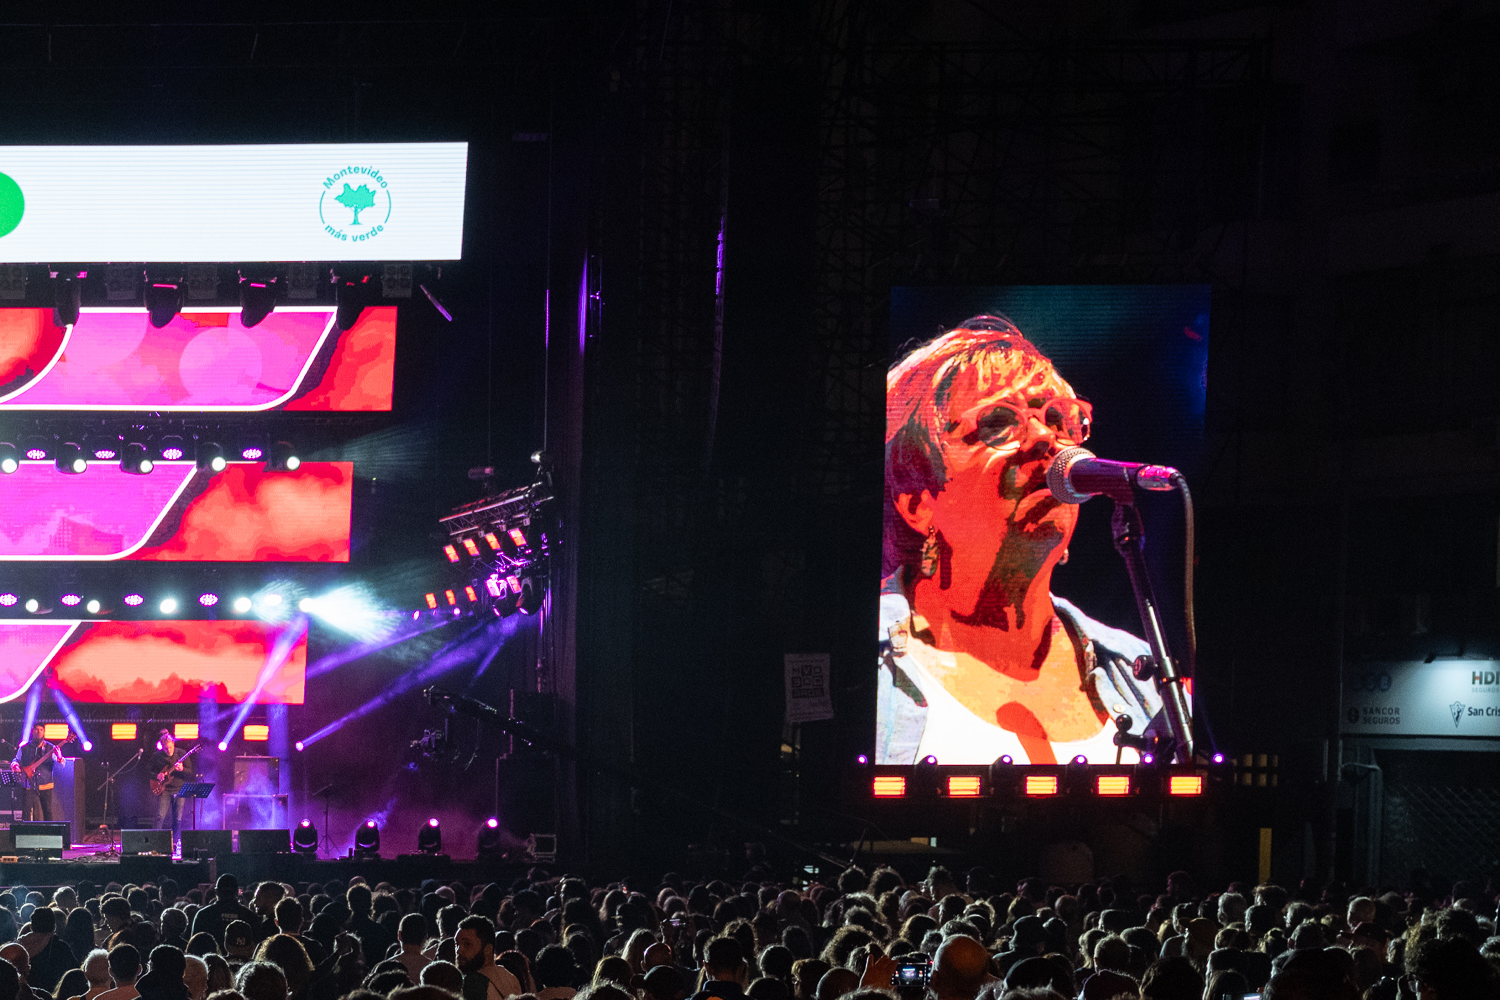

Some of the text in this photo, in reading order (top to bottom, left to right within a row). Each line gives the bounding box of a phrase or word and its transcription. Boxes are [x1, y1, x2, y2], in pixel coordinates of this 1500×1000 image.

[322, 165, 388, 189] Montevideo
[324, 224, 384, 242] más verde
[1471, 671, 1500, 685] HDI
[1363, 707, 1400, 715] SANCOR
[1468, 706, 1484, 717] San
[1363, 716, 1400, 725] SEGUROS
